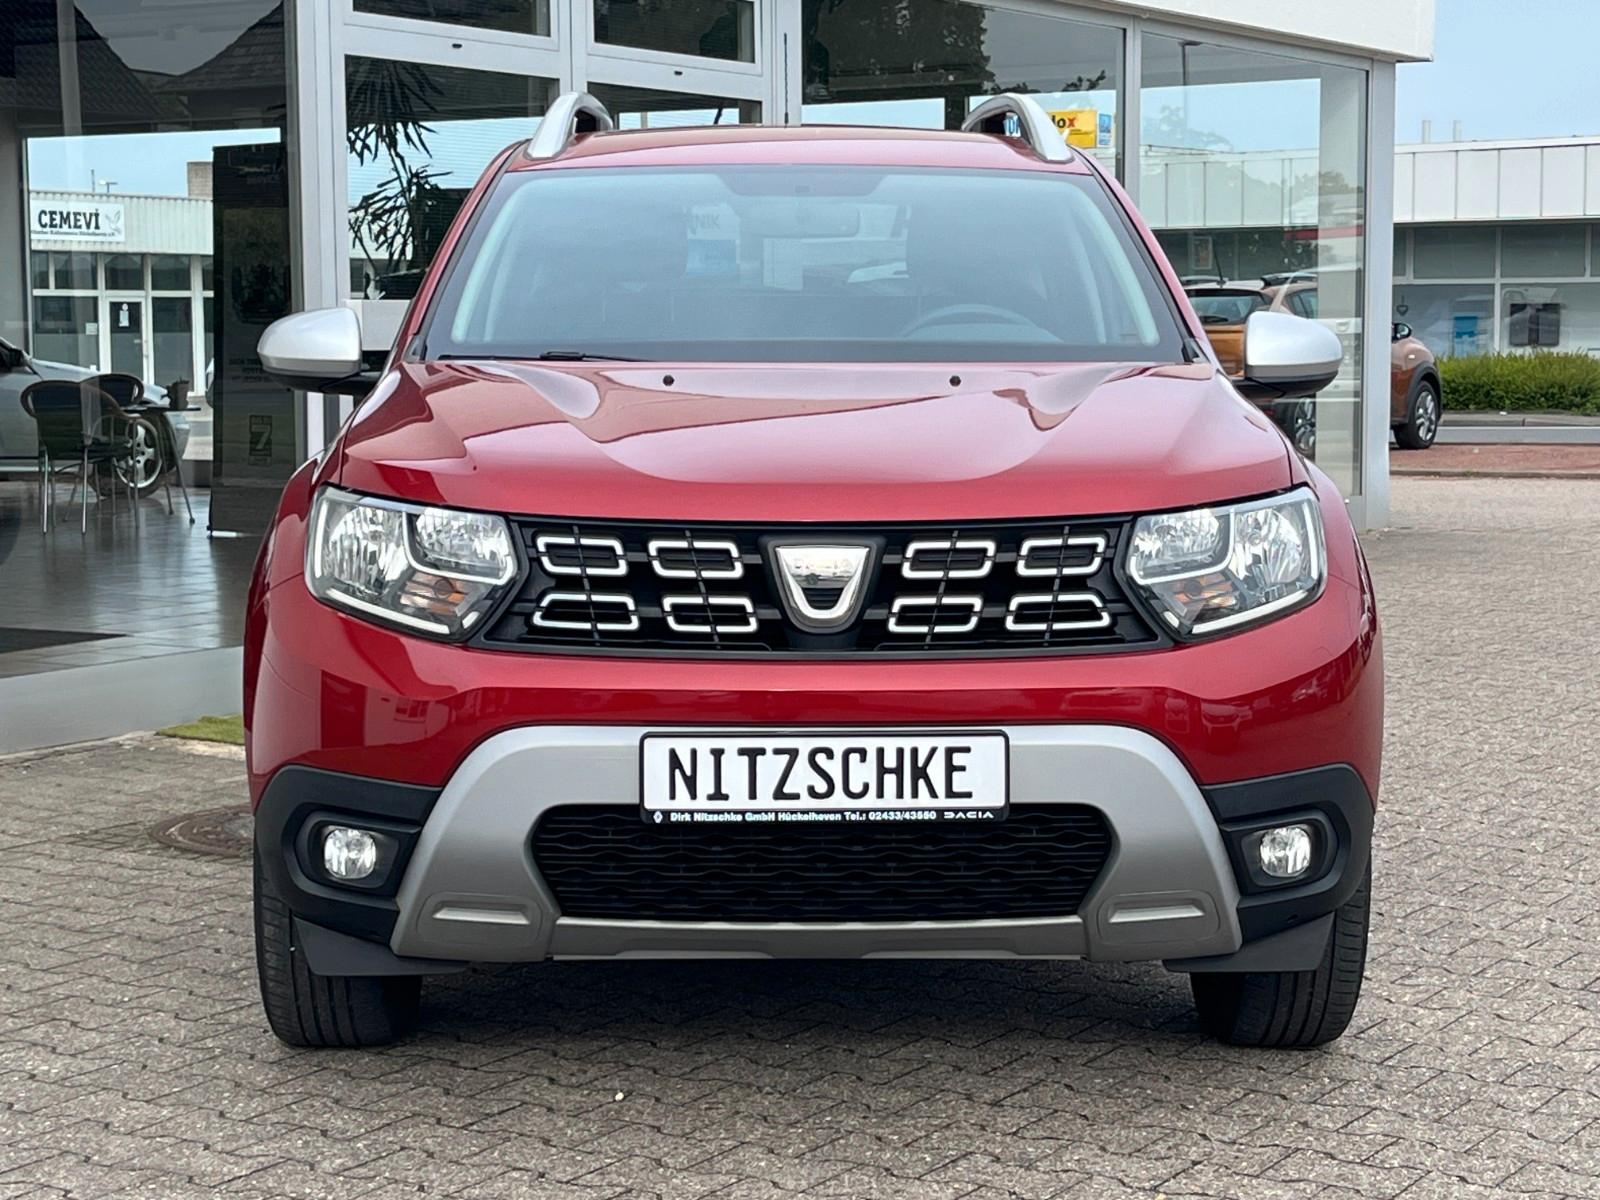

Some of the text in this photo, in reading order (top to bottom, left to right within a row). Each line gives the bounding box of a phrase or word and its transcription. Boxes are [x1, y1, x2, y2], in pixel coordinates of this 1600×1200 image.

[38, 208, 101, 230] CEMEVİ
[667, 745, 974, 802] NITZSCHKE
[670, 811, 691, 822] Dirk
[693, 811, 743, 822] Nitzschke
[744, 811, 775, 822] GmbH
[777, 811, 842, 821] Hückelhoven
[943, 810, 994, 820] DACIA
